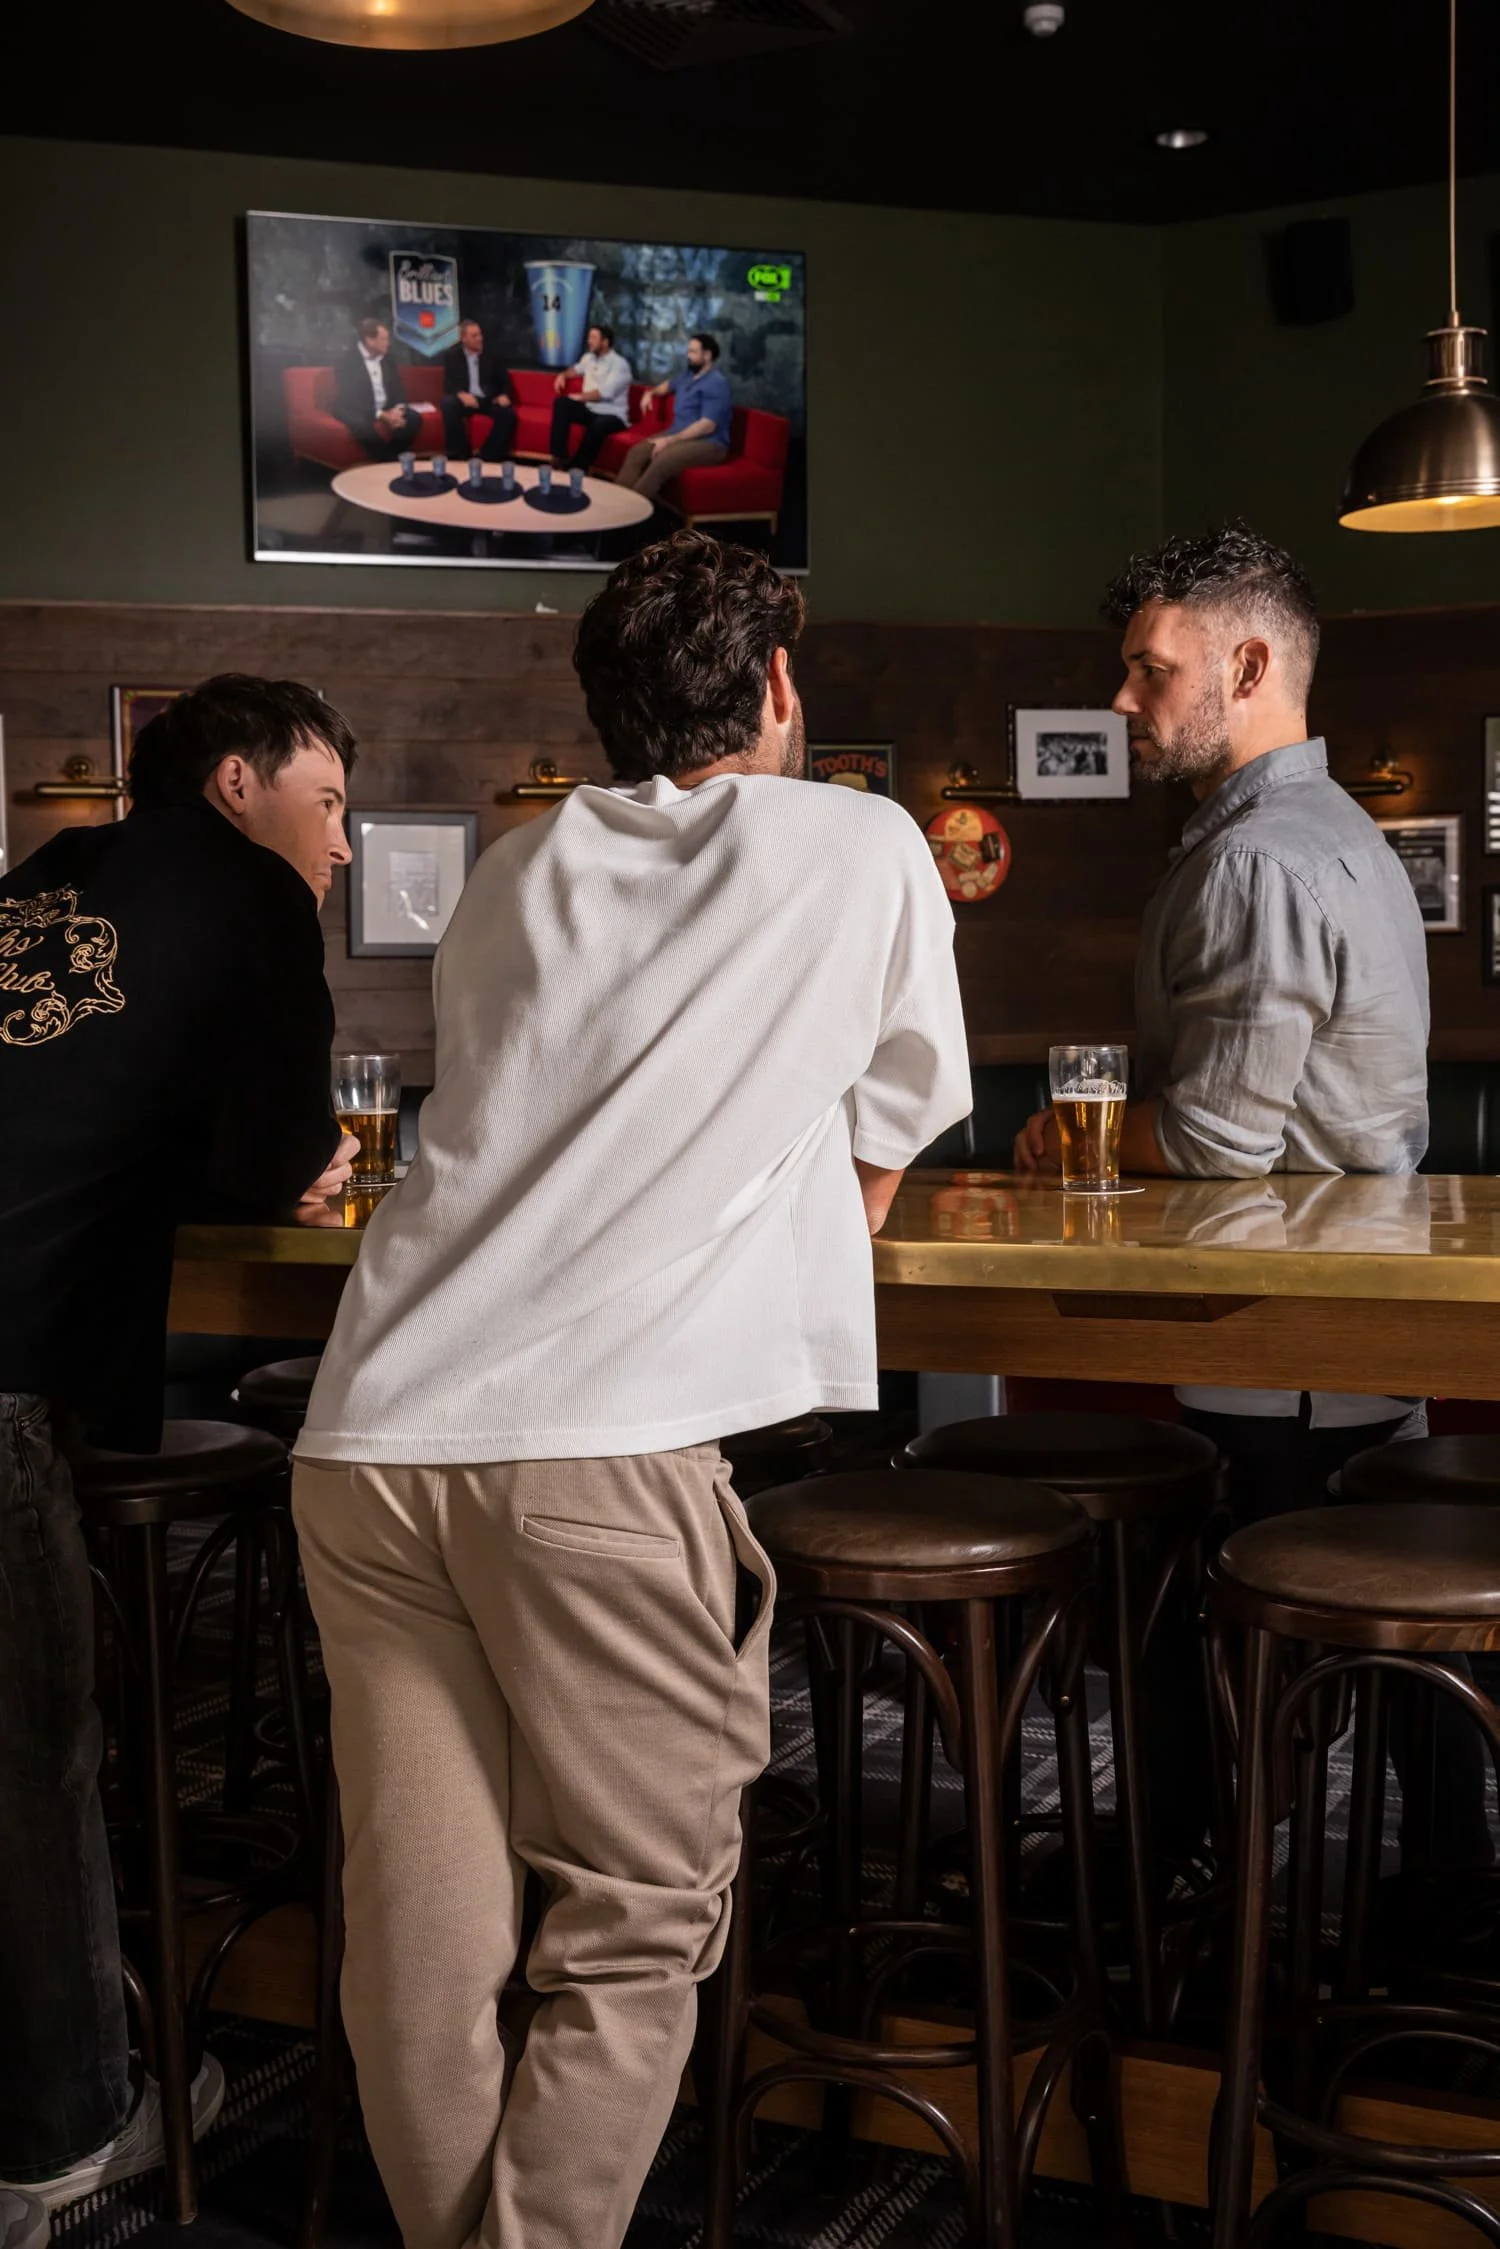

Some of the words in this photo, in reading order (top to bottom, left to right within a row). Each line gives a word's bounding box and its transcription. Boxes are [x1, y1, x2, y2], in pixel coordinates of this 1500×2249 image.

[399, 279, 454, 306] BLUES
[543, 294, 561, 312] 14
[812, 753, 889, 778] TOOTH'S
